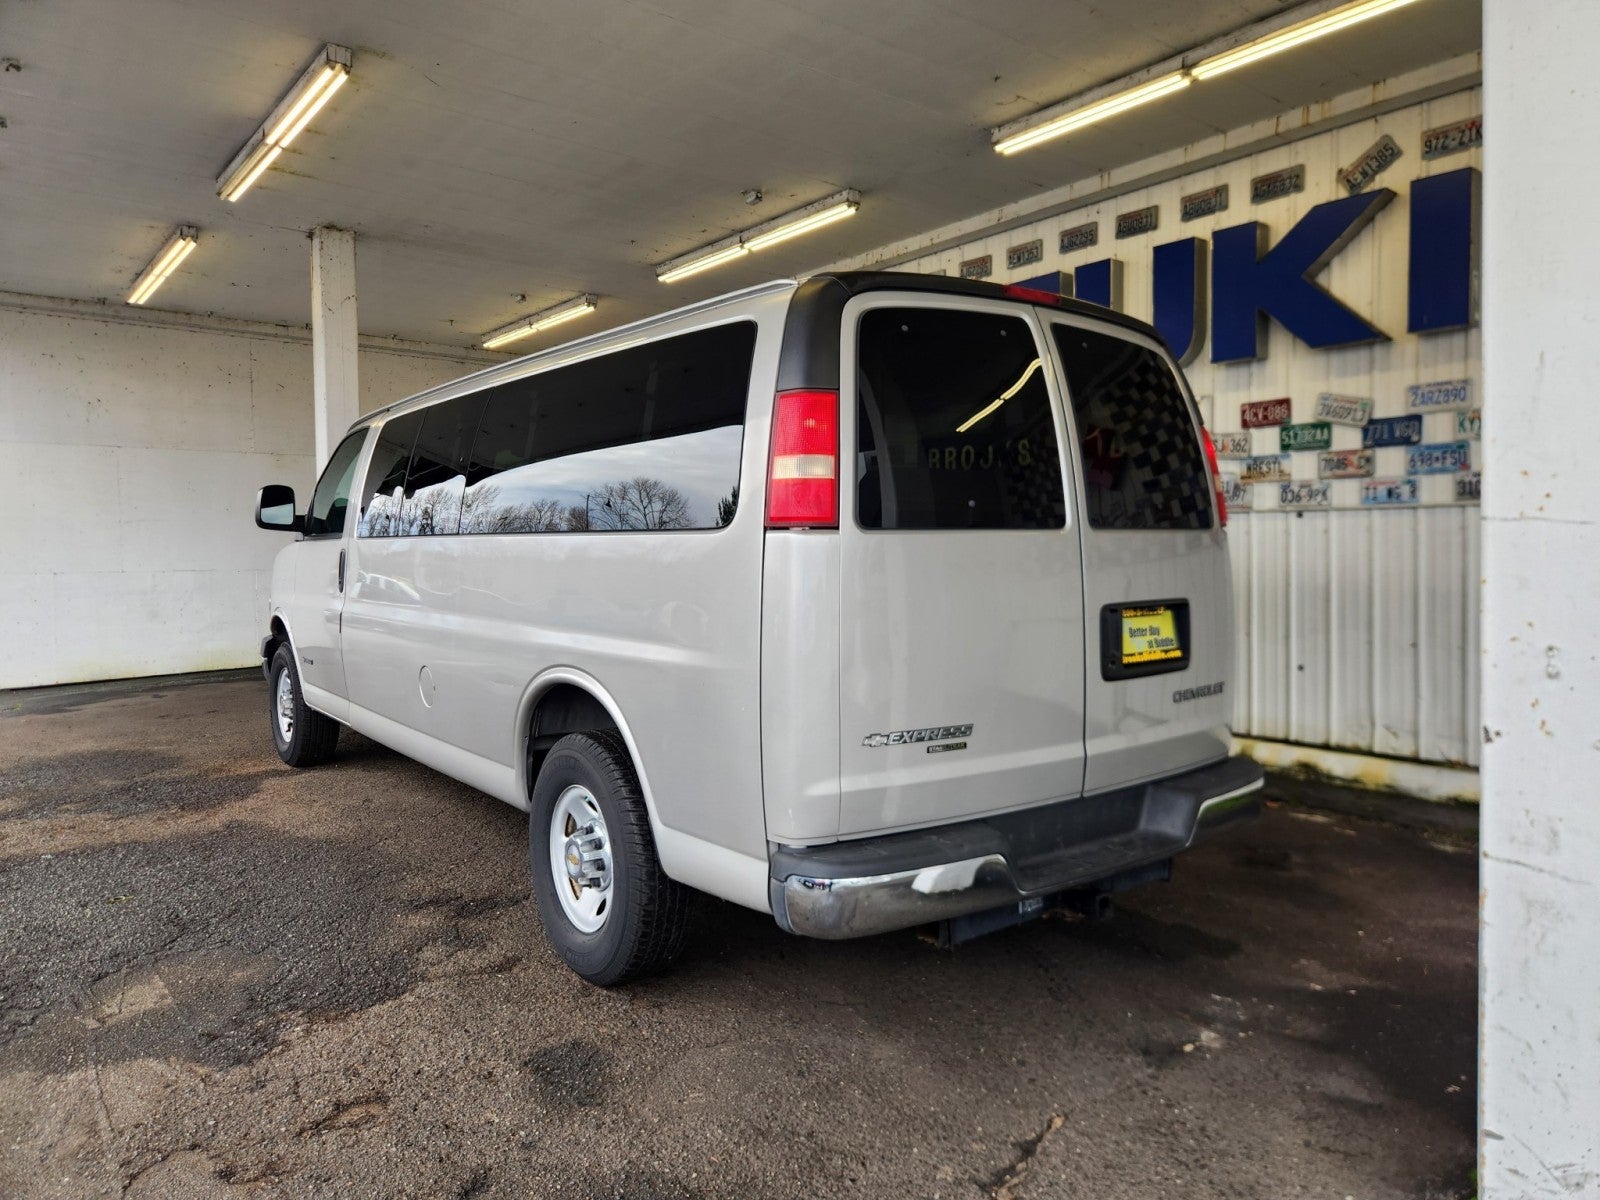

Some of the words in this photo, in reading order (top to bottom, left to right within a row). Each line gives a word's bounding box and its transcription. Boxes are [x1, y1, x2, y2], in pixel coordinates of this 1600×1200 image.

[1128, 627, 1148, 638] Better
[1172, 681, 1225, 703] CHEVROLET
[887, 723, 974, 746] EXPRESS
